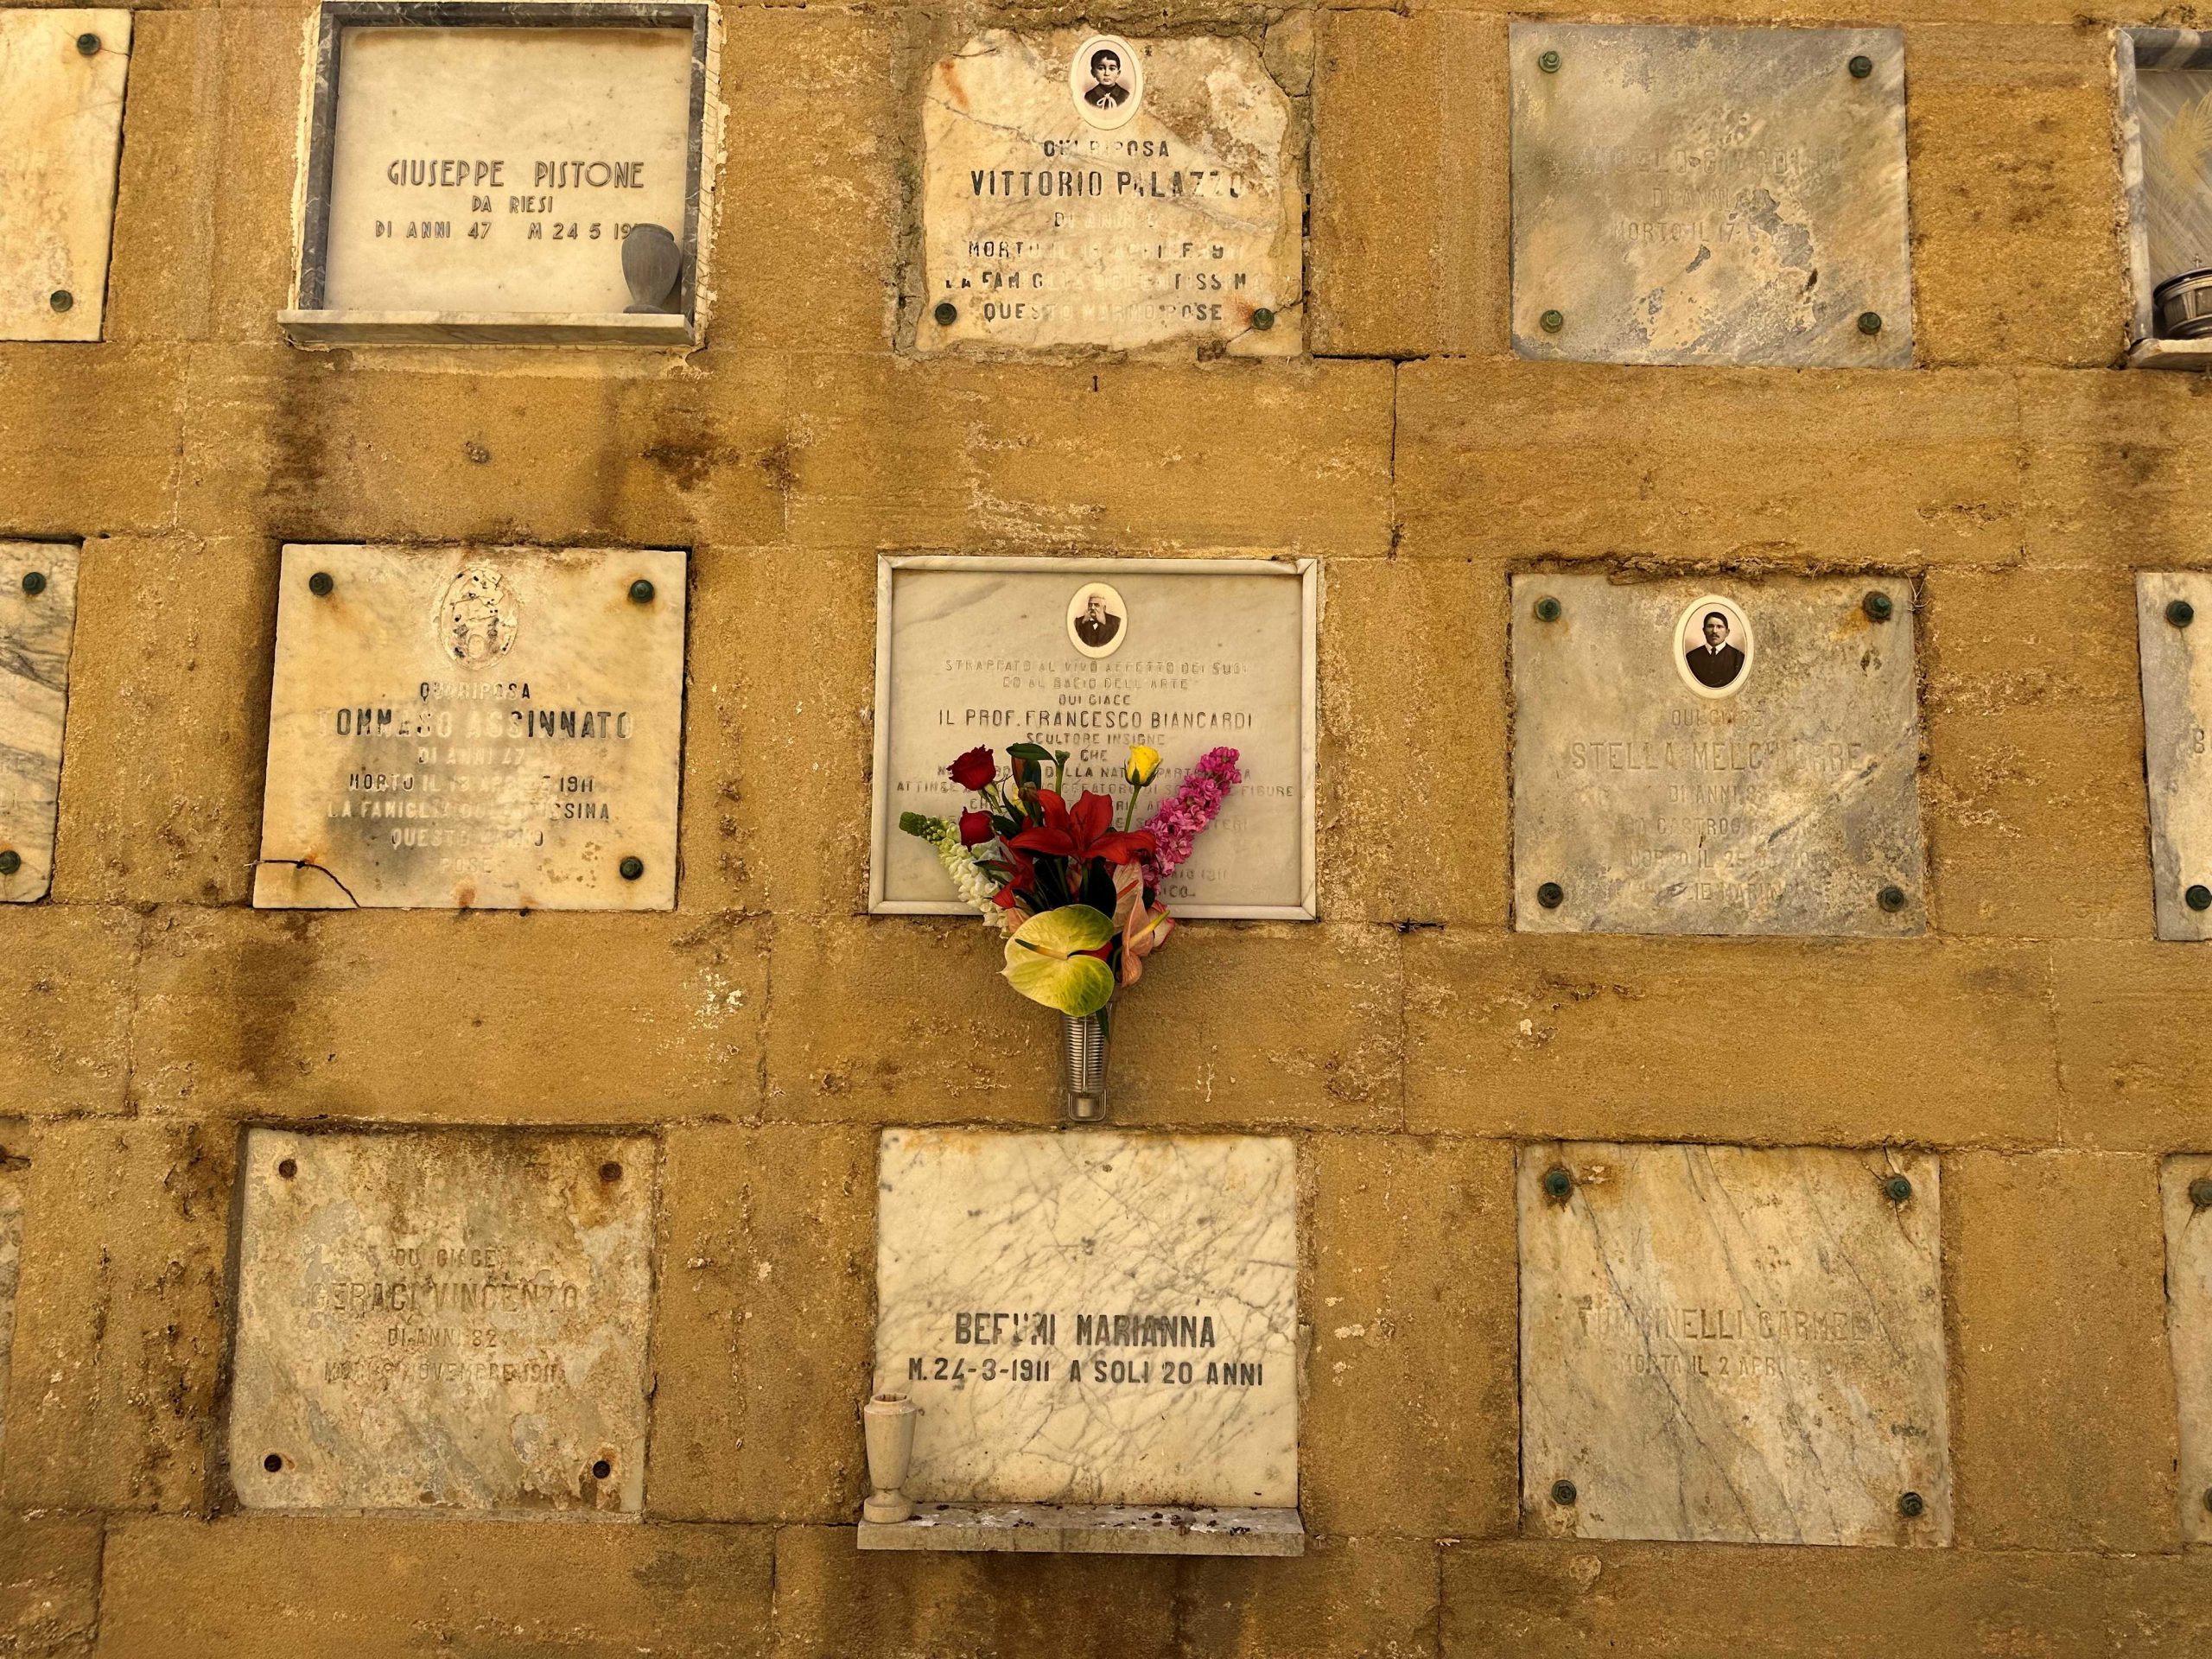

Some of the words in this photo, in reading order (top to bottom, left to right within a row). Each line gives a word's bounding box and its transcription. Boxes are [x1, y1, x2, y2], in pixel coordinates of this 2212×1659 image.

[387, 159, 505, 188] GIUSEPPE
[534, 161, 645, 188] PISTONE
[970, 170, 1103, 197] VITTORIO
[472, 195, 492, 213] DA
[509, 195, 553, 213] RIESI
[375, 220, 392, 238] DI
[406, 220, 451, 239] ANNI
[467, 221, 492, 239] 47
[528, 223, 542, 240] M
[553, 223, 578, 240] 24
[588, 223, 601, 240] 5
[945, 659, 1031, 672] STRAPPATO
[1150, 678, 1189, 690] ARTE
[465, 709, 635, 741] ASSINNATO
[939, 709, 955, 726] IL
[1026, 710, 1142, 729] FRANCESCO
[1150, 711, 1252, 730] BIANCARDI
[1027, 733, 1100, 746] SCULTORE
[1107, 734, 1166, 747] INSIGNE
[1080, 749, 1108, 763] CHE
[1570, 741, 1675, 772] STELLA
[1046, 766, 1094, 779] DLLA
[1076, 1313, 1216, 1349] MARIANNA
[1070, 1359, 1082, 1383] A
[1094, 1360, 1150, 1384] SOLI
[1161, 1361, 1193, 1385] 20
[1206, 1361, 1263, 1386] ANNI
[1719, 1356, 1730, 1376] 2
